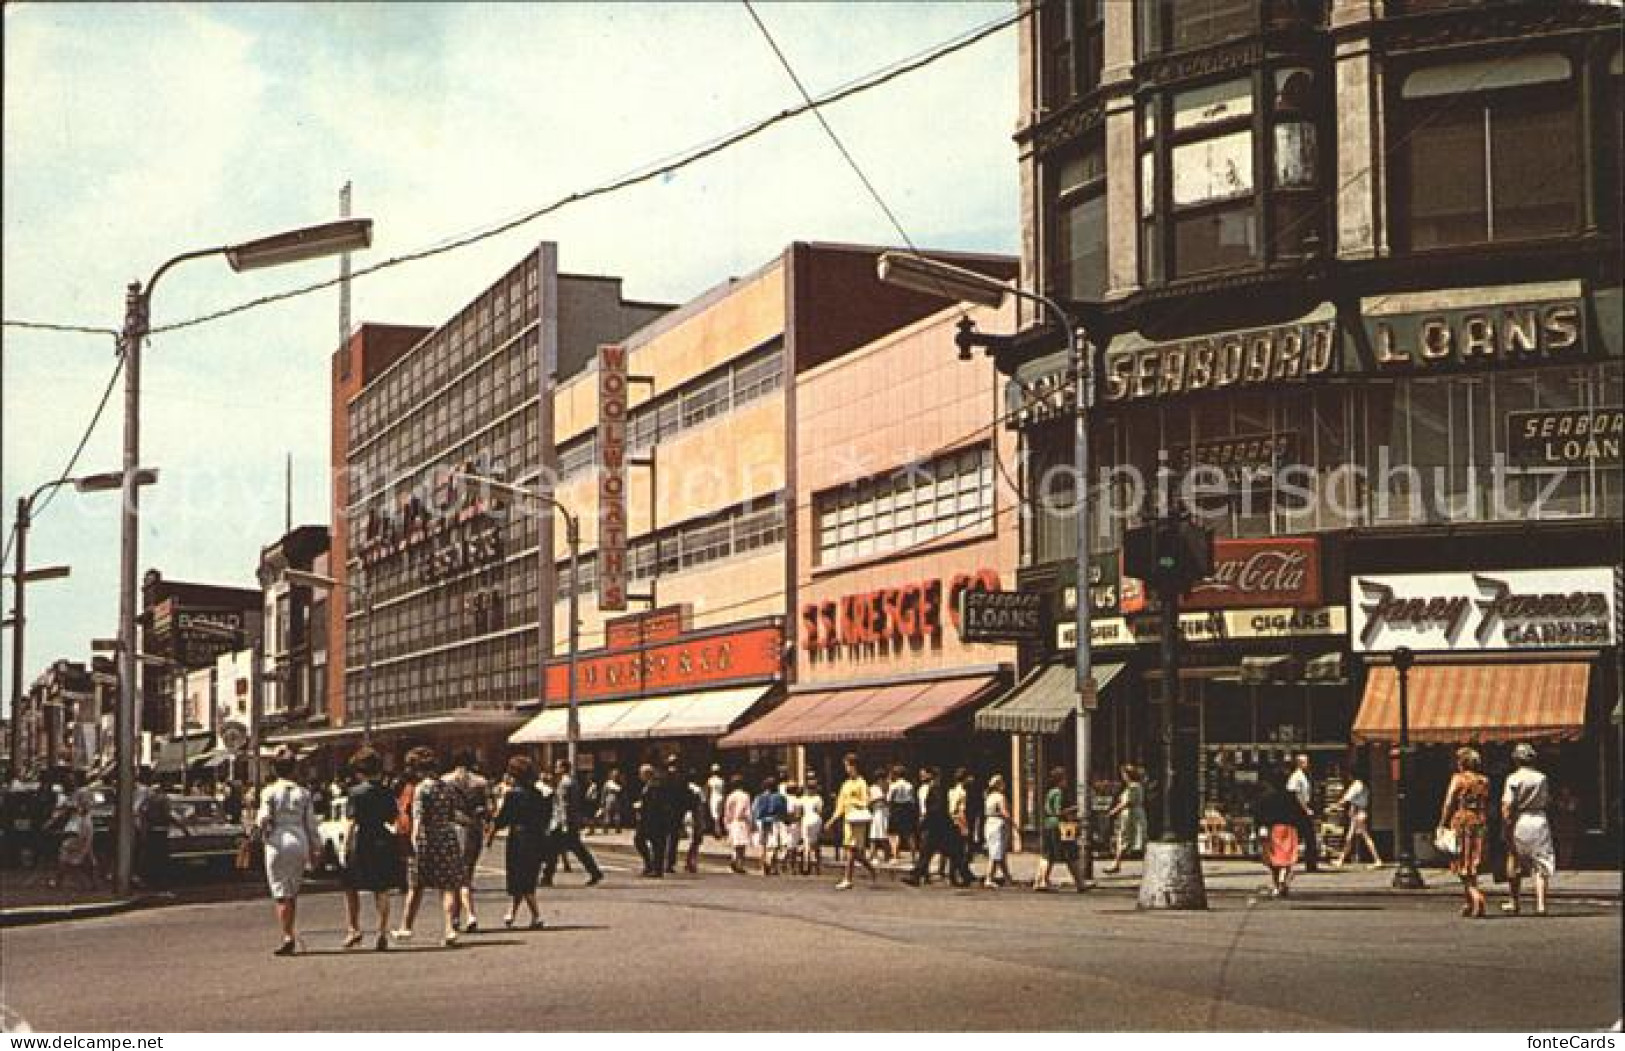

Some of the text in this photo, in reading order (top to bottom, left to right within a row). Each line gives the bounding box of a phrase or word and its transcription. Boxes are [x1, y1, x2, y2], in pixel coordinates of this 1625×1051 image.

[1375, 305, 1579, 362] LOANS
[1107, 323, 1334, 399] SEABOARD
[1545, 439, 1619, 461] LOAN
[969, 608, 1040, 628] LOANS
[1250, 612, 1331, 631] CIGARS
